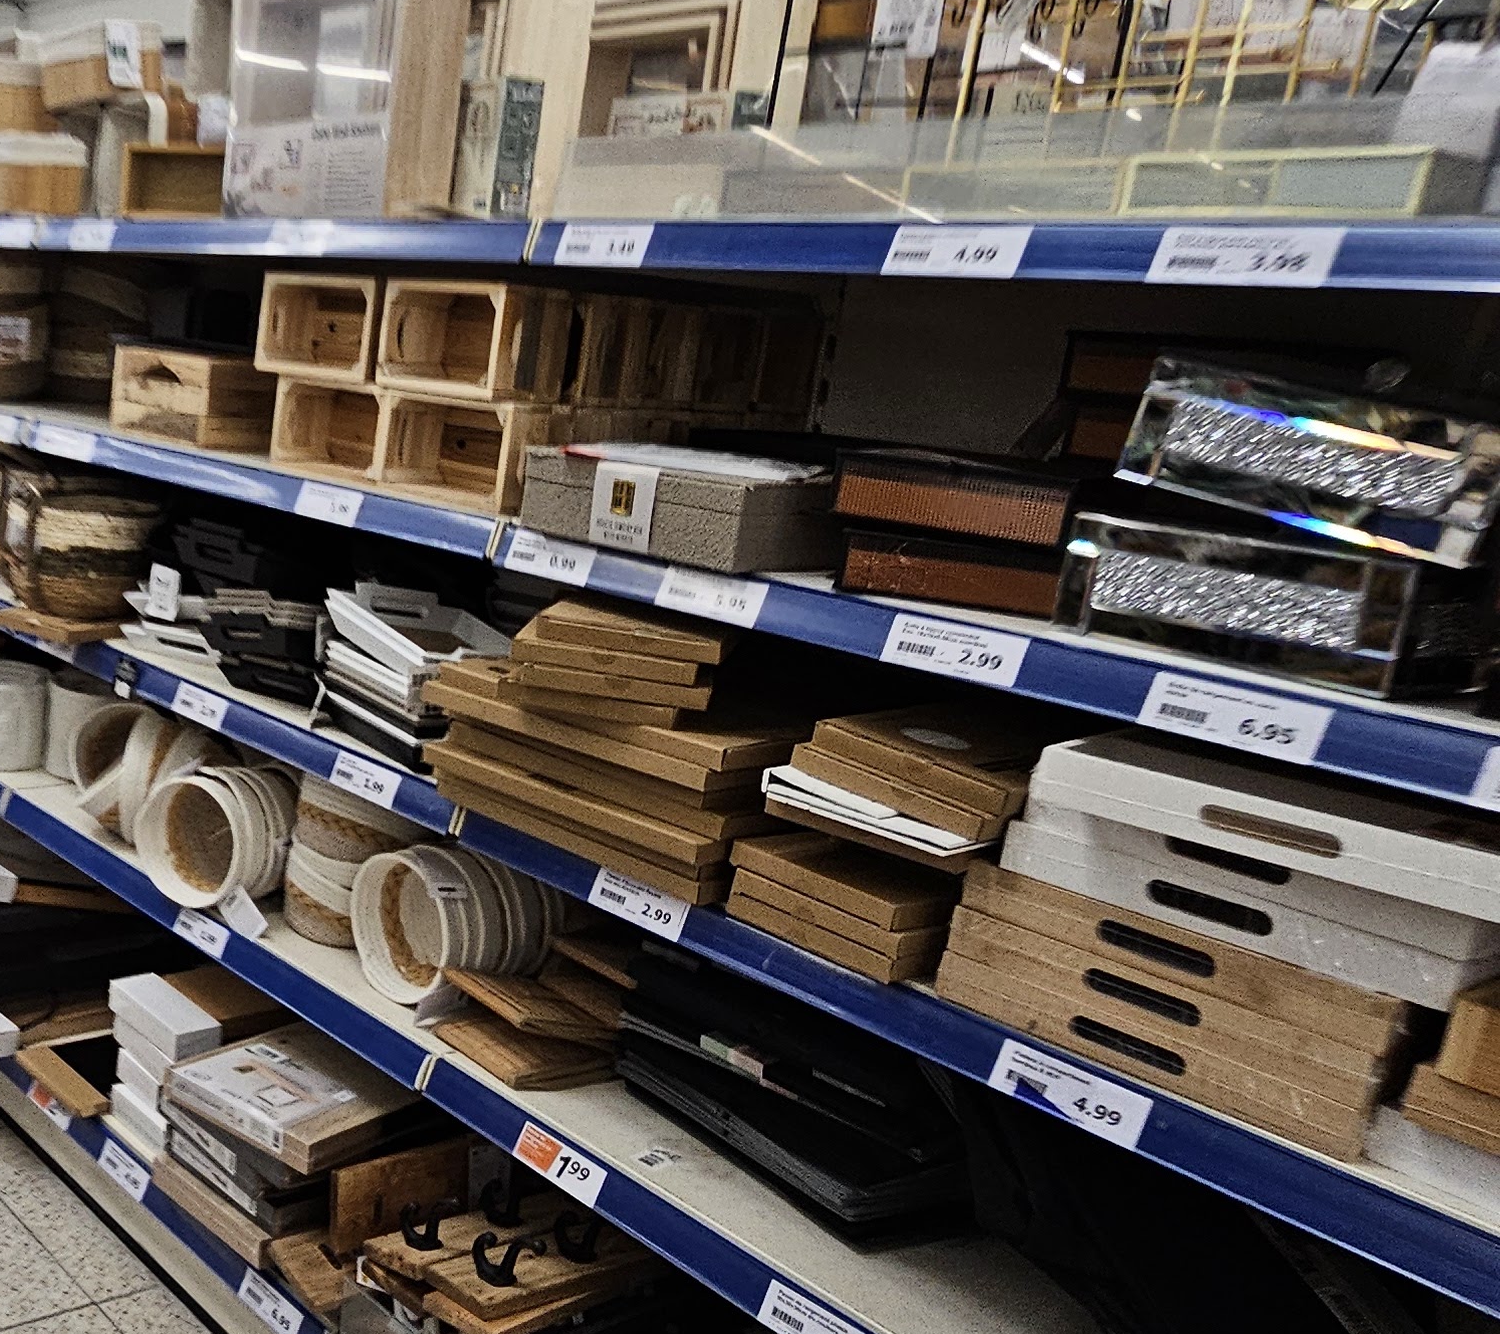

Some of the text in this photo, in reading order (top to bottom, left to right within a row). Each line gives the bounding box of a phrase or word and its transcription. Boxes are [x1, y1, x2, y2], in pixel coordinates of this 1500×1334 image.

[953, 245, 1000, 265] 4.99
[958, 647, 1004, 671] 2.99
[1238, 718, 1298, 745] 6.95
[641, 902, 672, 926] 2.99
[1072, 1096, 1122, 1126] 4.99
